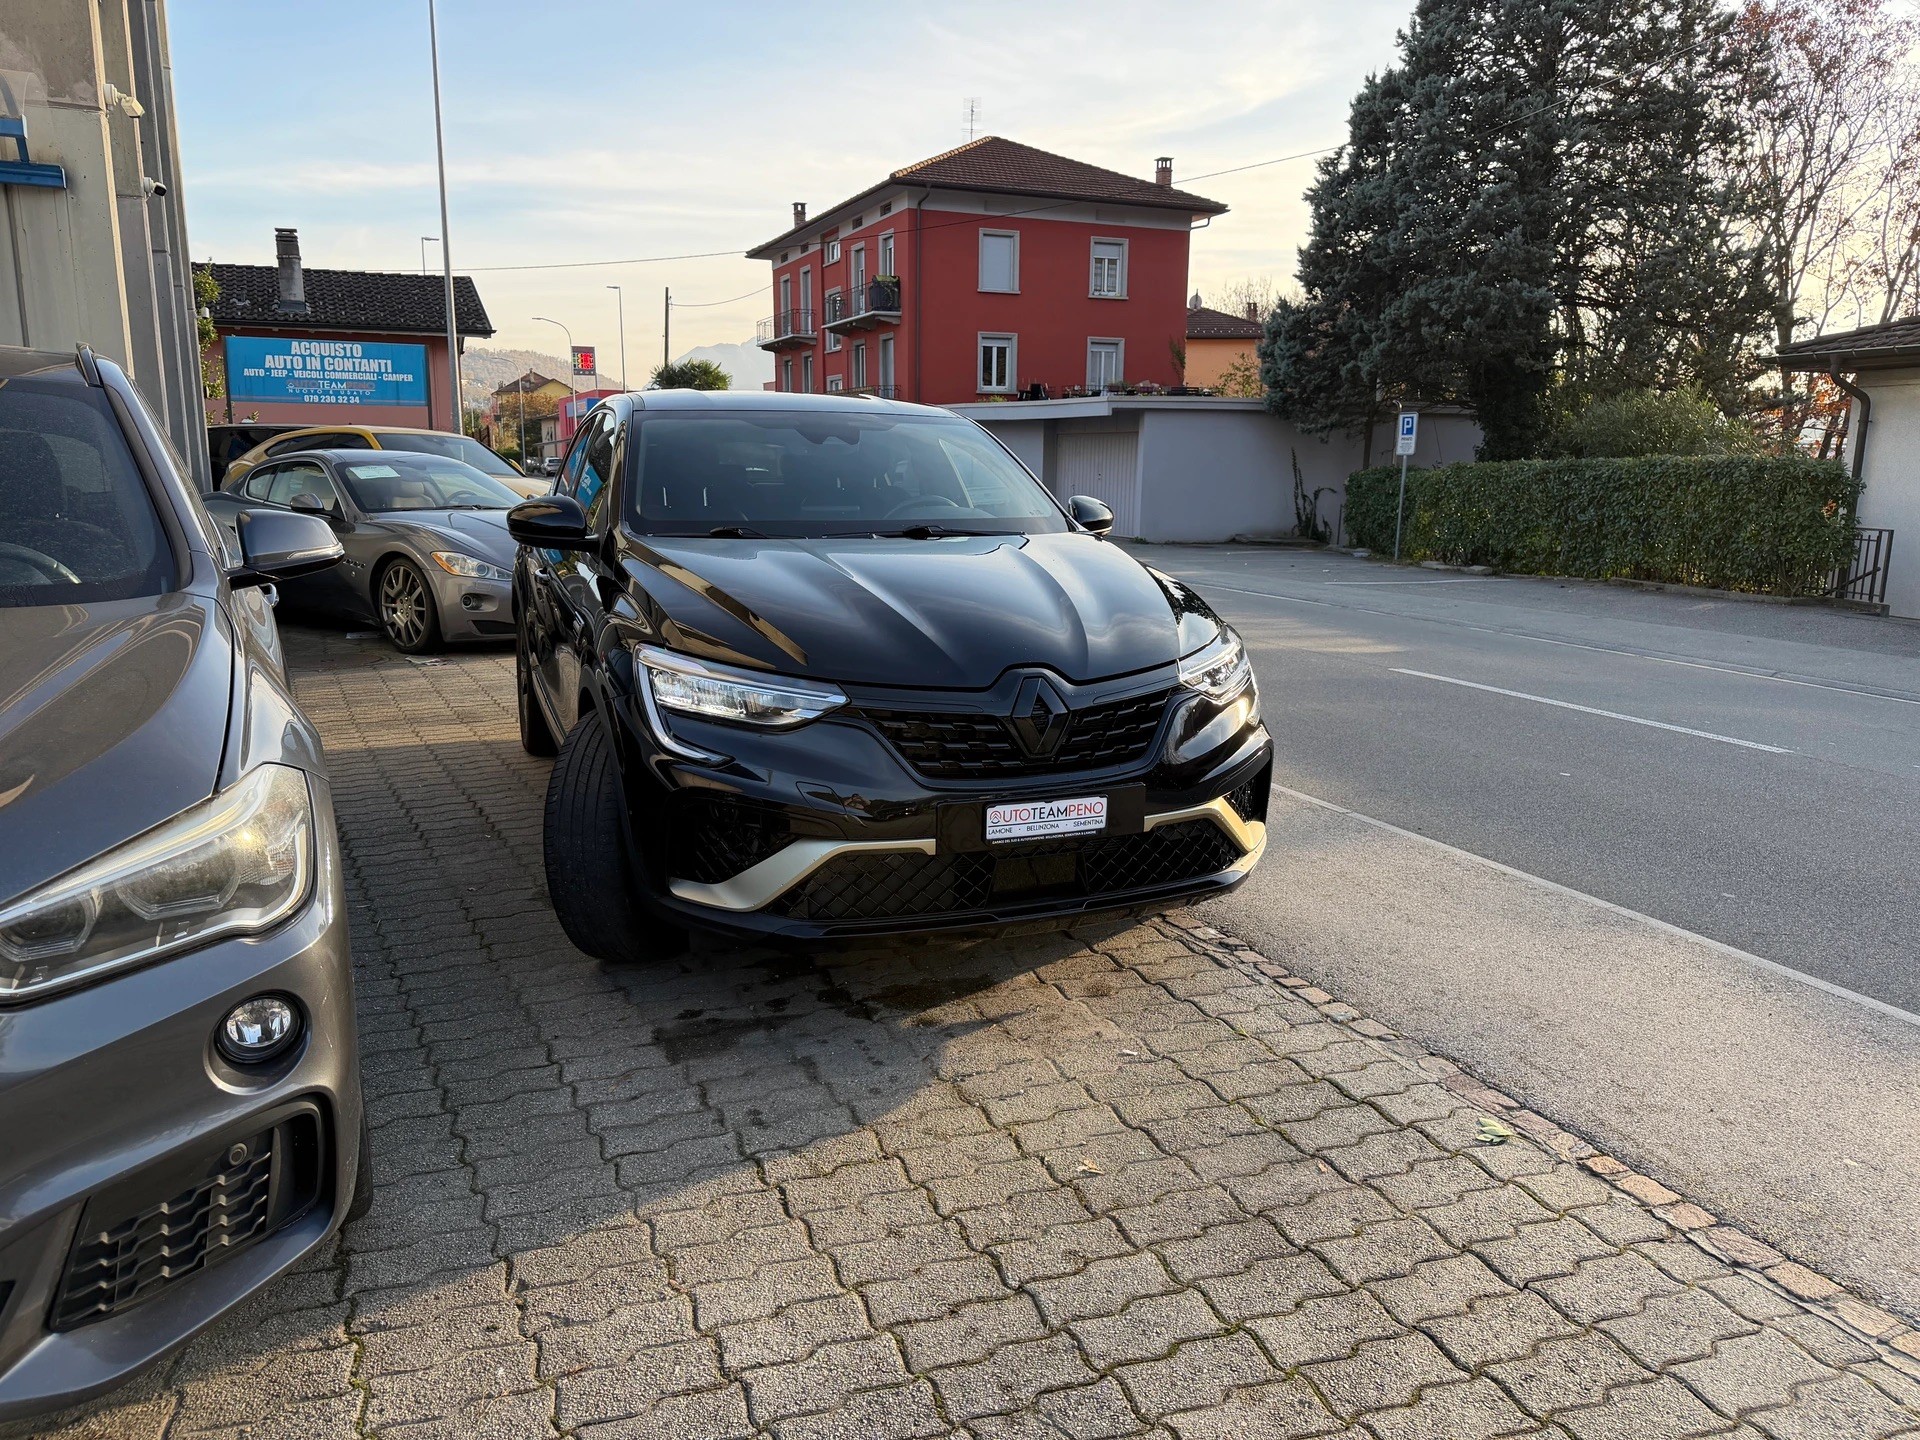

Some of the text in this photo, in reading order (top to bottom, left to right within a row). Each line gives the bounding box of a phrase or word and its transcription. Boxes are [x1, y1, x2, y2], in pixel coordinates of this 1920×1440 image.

[291, 341, 362, 358] ACQUISTO
[264, 354, 392, 373] AUTO IN CONTANTI
[243, 368, 265, 377] AUTO
[270, 369, 288, 378] JEEP
[293, 370, 323, 379] VEICOLI
[324, 371, 377, 380] COMMERCIALI
[382, 373, 413, 382] CAMPER
[304, 394, 360, 404] 079 230 32 34
[1403, 417, 1412, 434] P
[988, 819, 1104, 836] LAMONE BELLINZONA SEMENTINA
